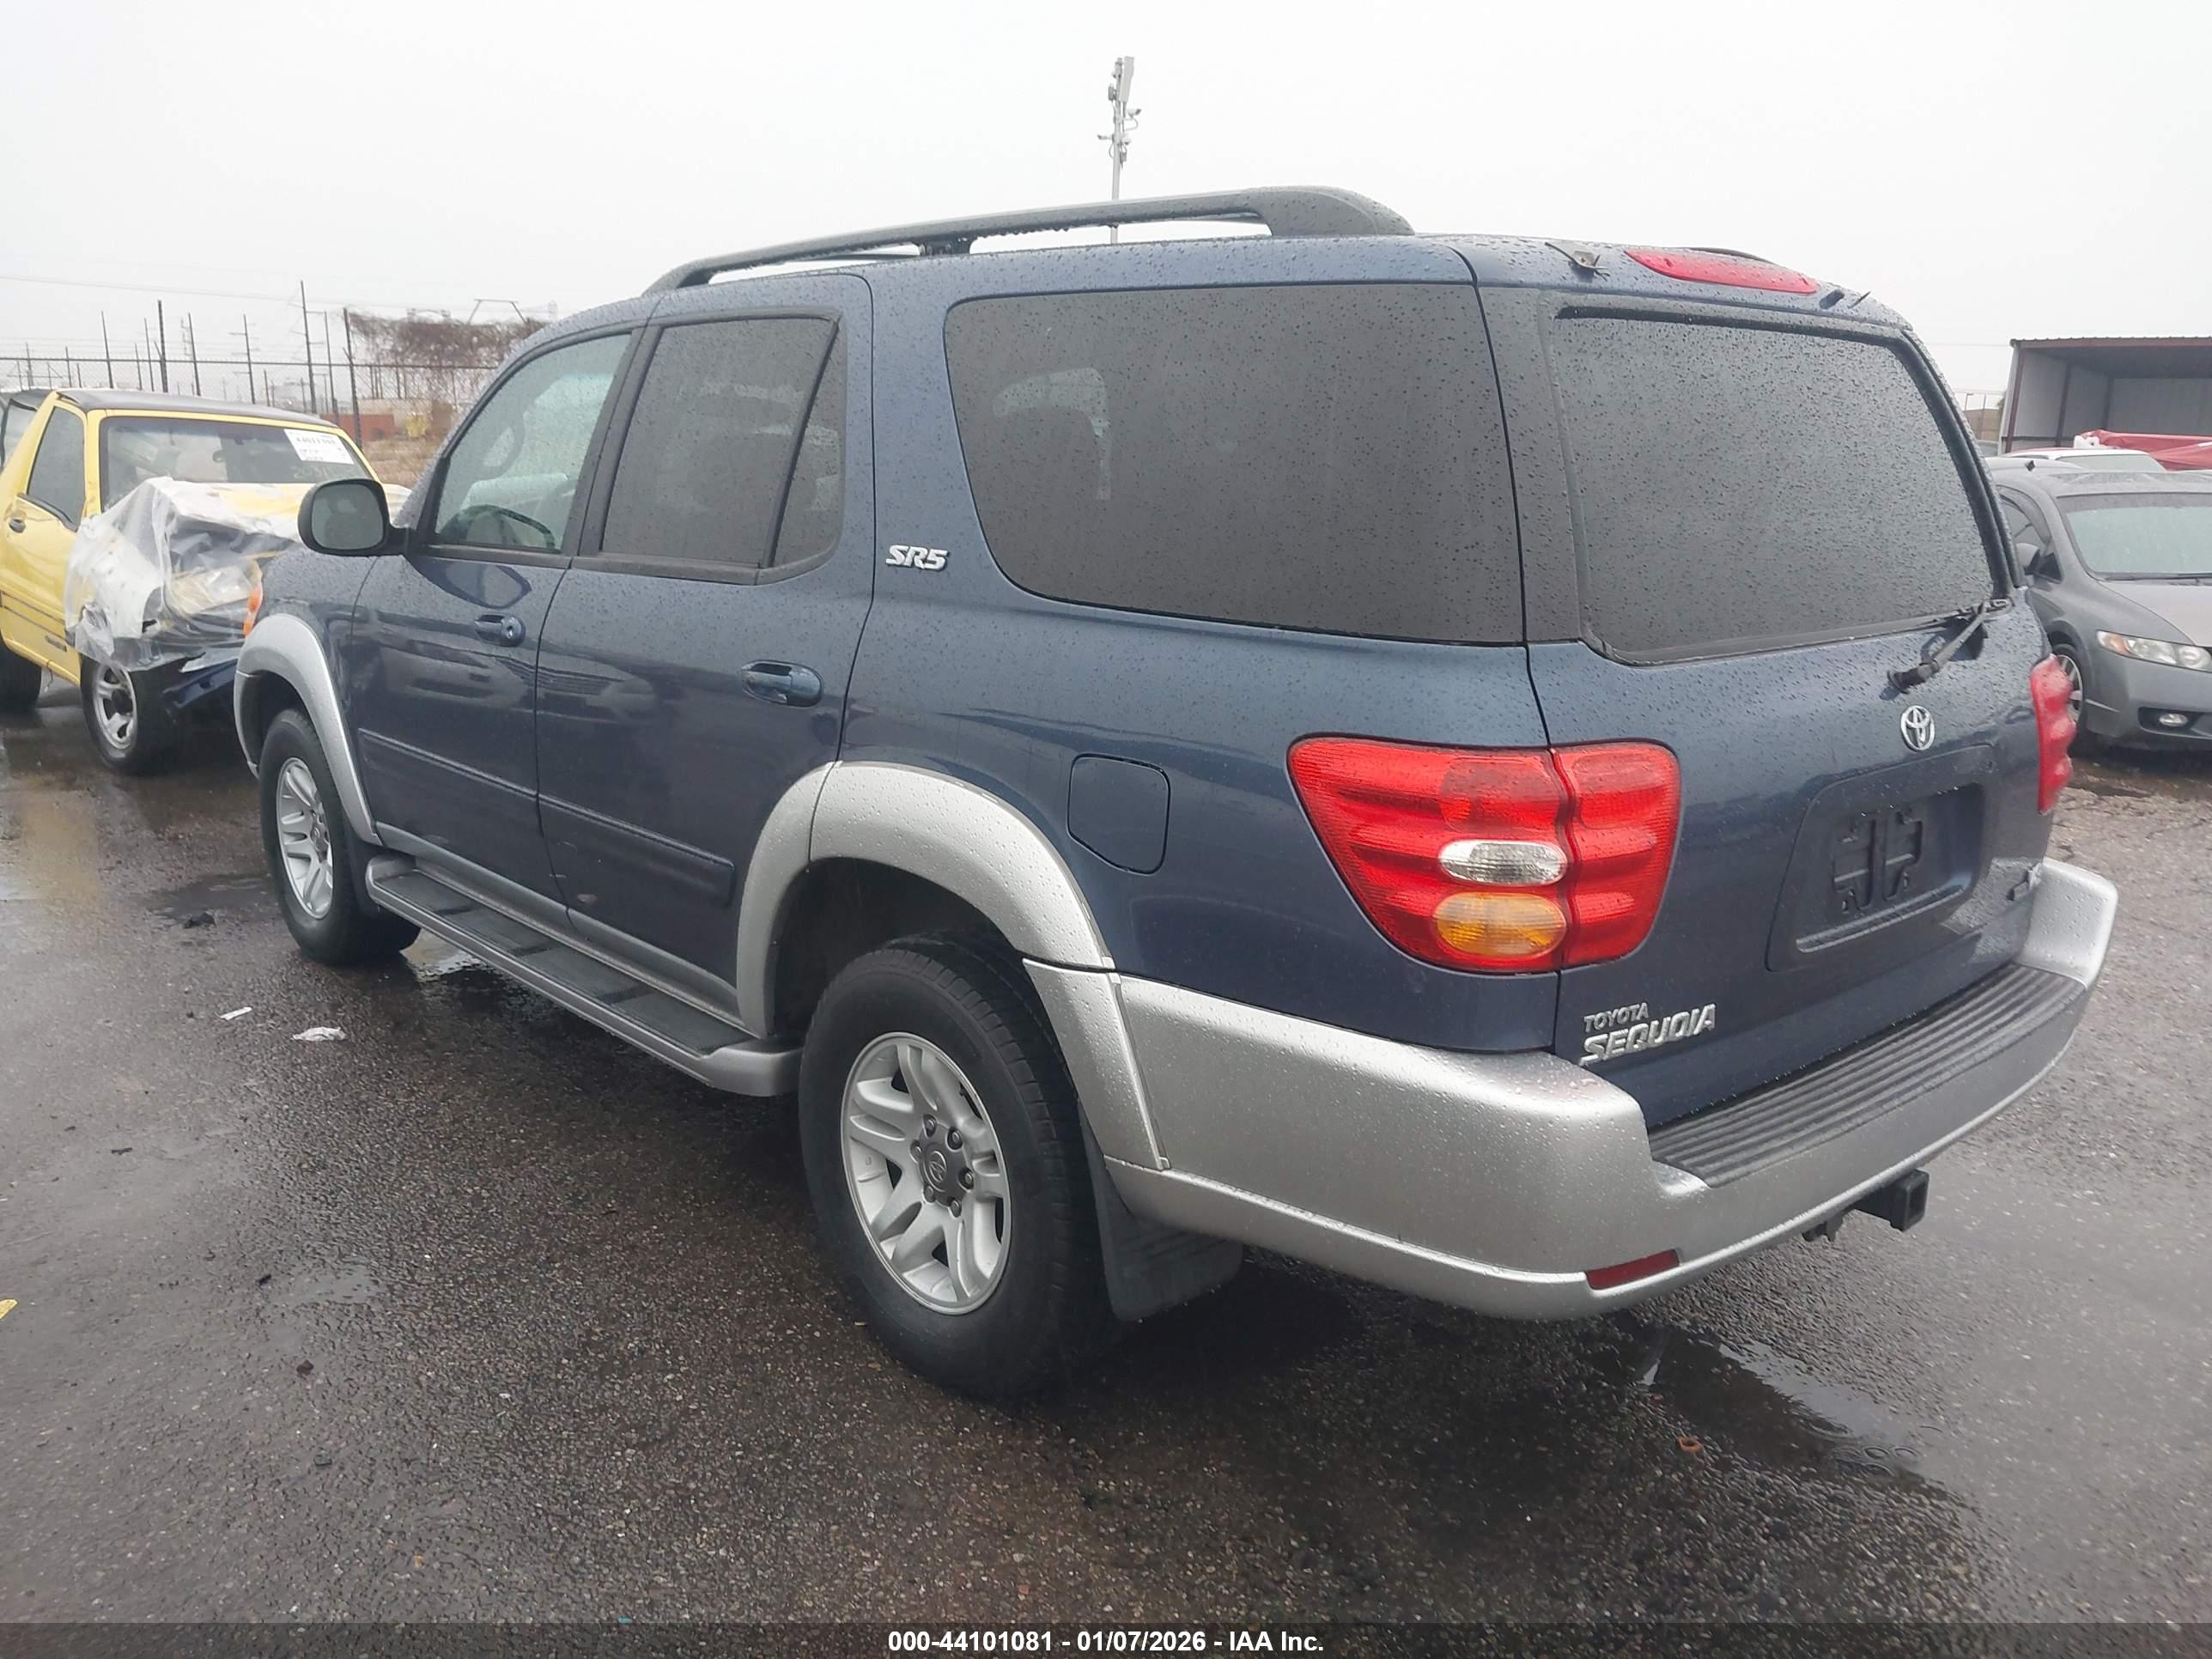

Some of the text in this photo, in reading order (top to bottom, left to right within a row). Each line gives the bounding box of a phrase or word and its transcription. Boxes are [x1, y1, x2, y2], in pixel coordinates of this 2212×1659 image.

[885, 544, 949, 570] SR5
[1583, 1001, 1649, 1032] TOYOTA
[1578, 1003, 1717, 1066] SEQUOIA
